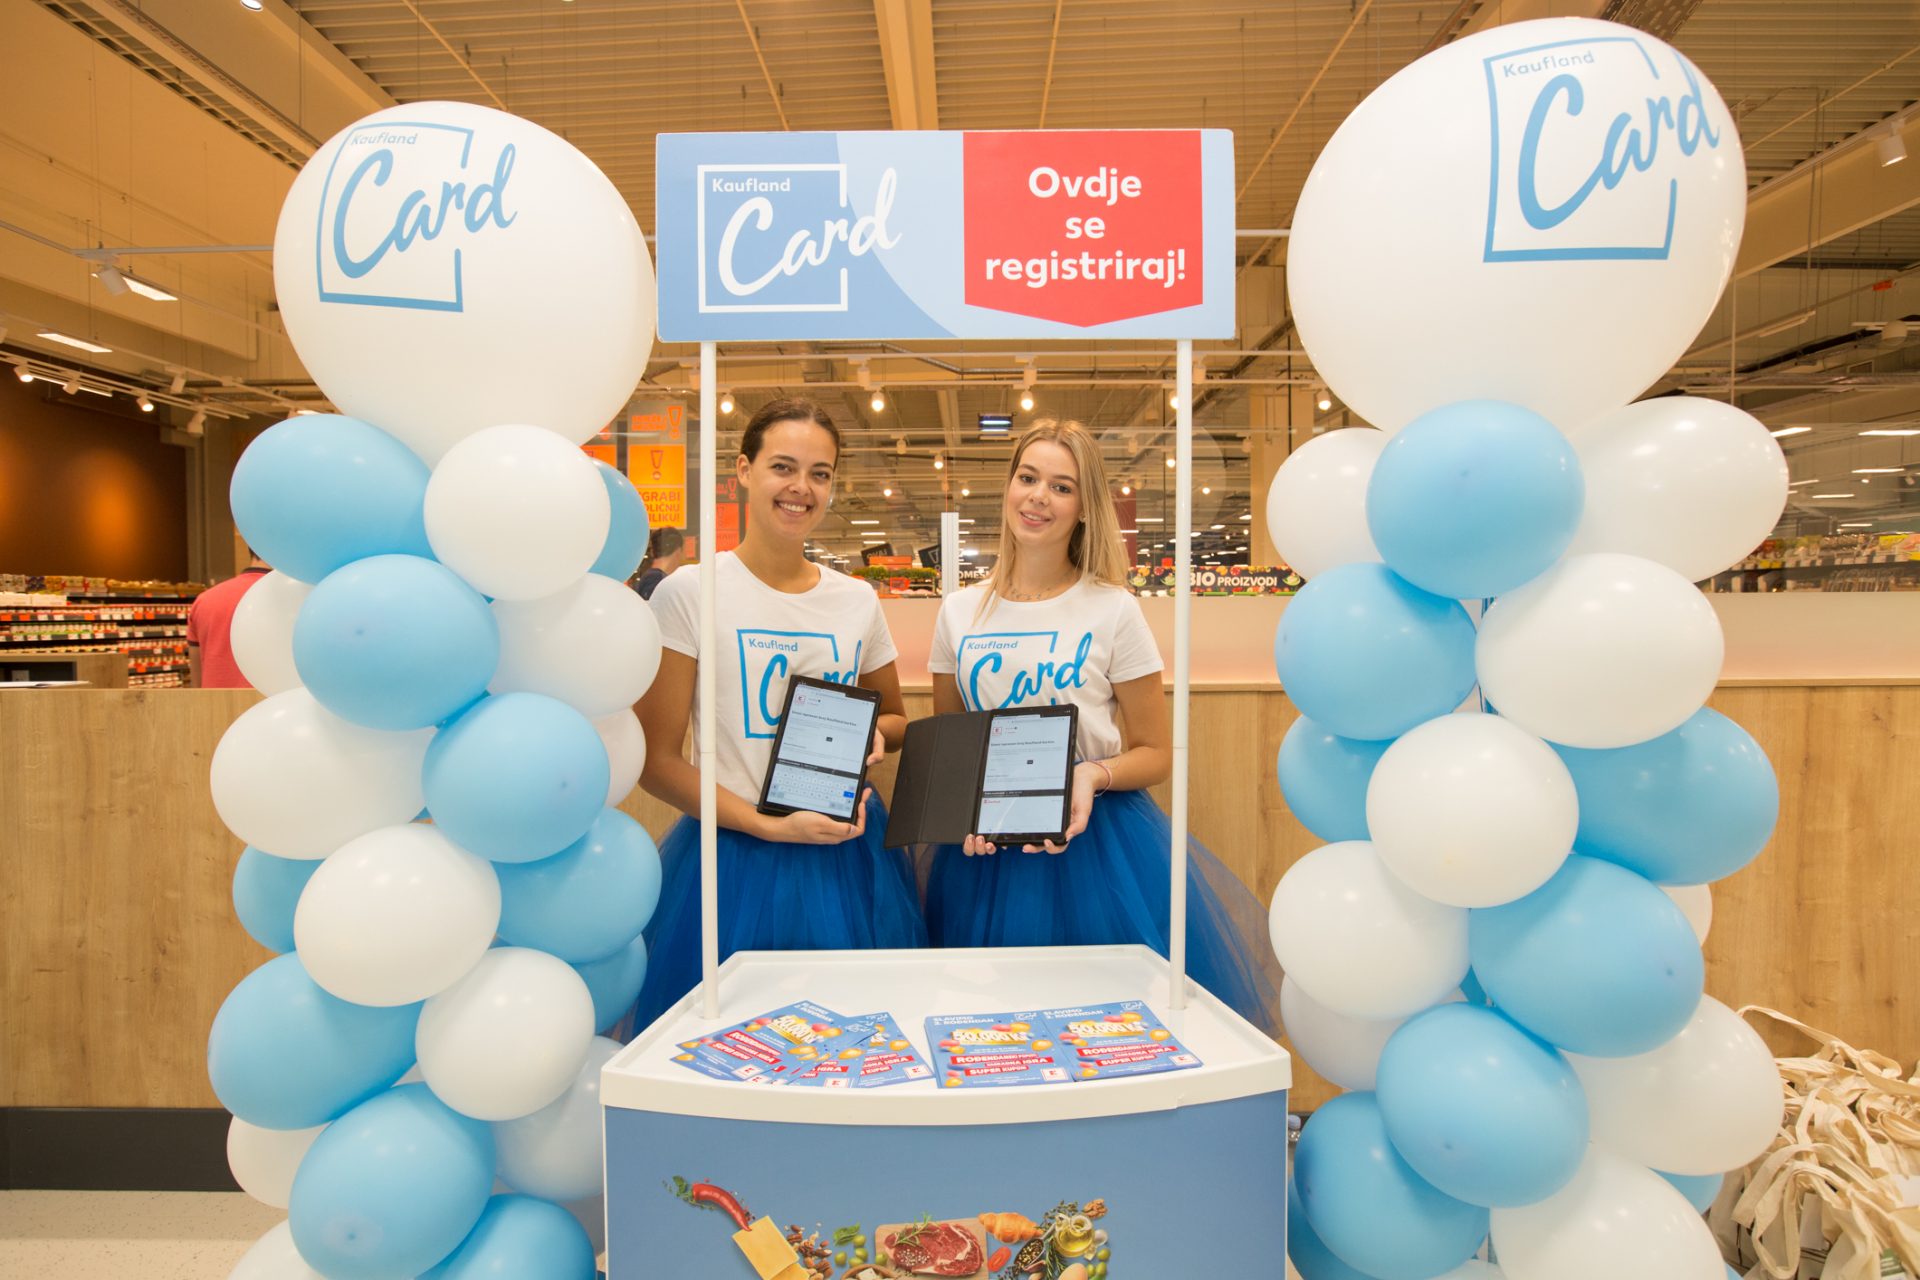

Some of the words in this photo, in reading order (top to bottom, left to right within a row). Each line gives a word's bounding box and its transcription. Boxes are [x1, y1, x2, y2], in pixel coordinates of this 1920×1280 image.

[1503, 50, 1595, 78] Kaufland
[350, 131, 418, 146] Kaufland
[1518, 48, 1720, 230] Card
[712, 178, 791, 192] Kaufland
[1028, 166, 1142, 206] Ovdje
[333, 143, 518, 279] Card
[718, 167, 903, 296] Card
[1065, 216, 1105, 239] se
[985, 248, 1186, 289] registriraj!
[639, 491, 681, 502] GRABI
[1190, 571, 1216, 587] BIO
[1217, 576, 1278, 587] PROIZVODI
[748, 638, 798, 652] Kaufland
[967, 640, 1019, 651] Kaufland
[969, 631, 1093, 712] Card
[969, 1067, 1001, 1075] SUPER
